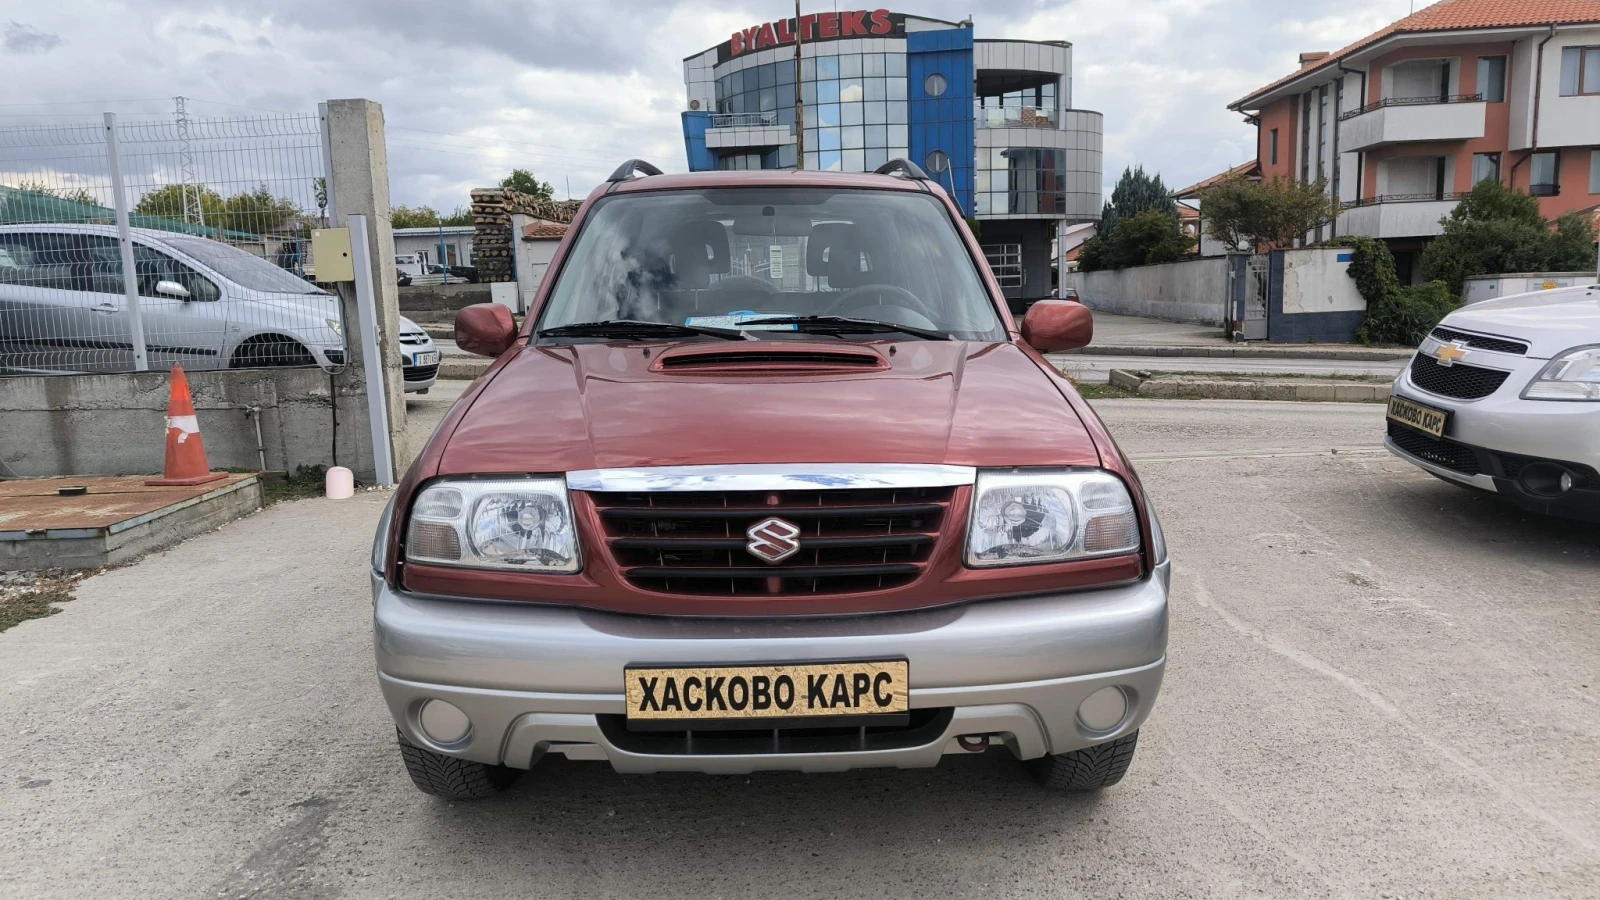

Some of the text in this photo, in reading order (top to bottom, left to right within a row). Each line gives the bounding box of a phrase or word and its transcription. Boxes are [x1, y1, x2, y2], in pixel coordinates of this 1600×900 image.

[731, 9, 892, 56] BYALTEKS
[1391, 400, 1442, 433] ХАСКОВО КАРС
[638, 671, 893, 712] ХАСКОВО КАРС
